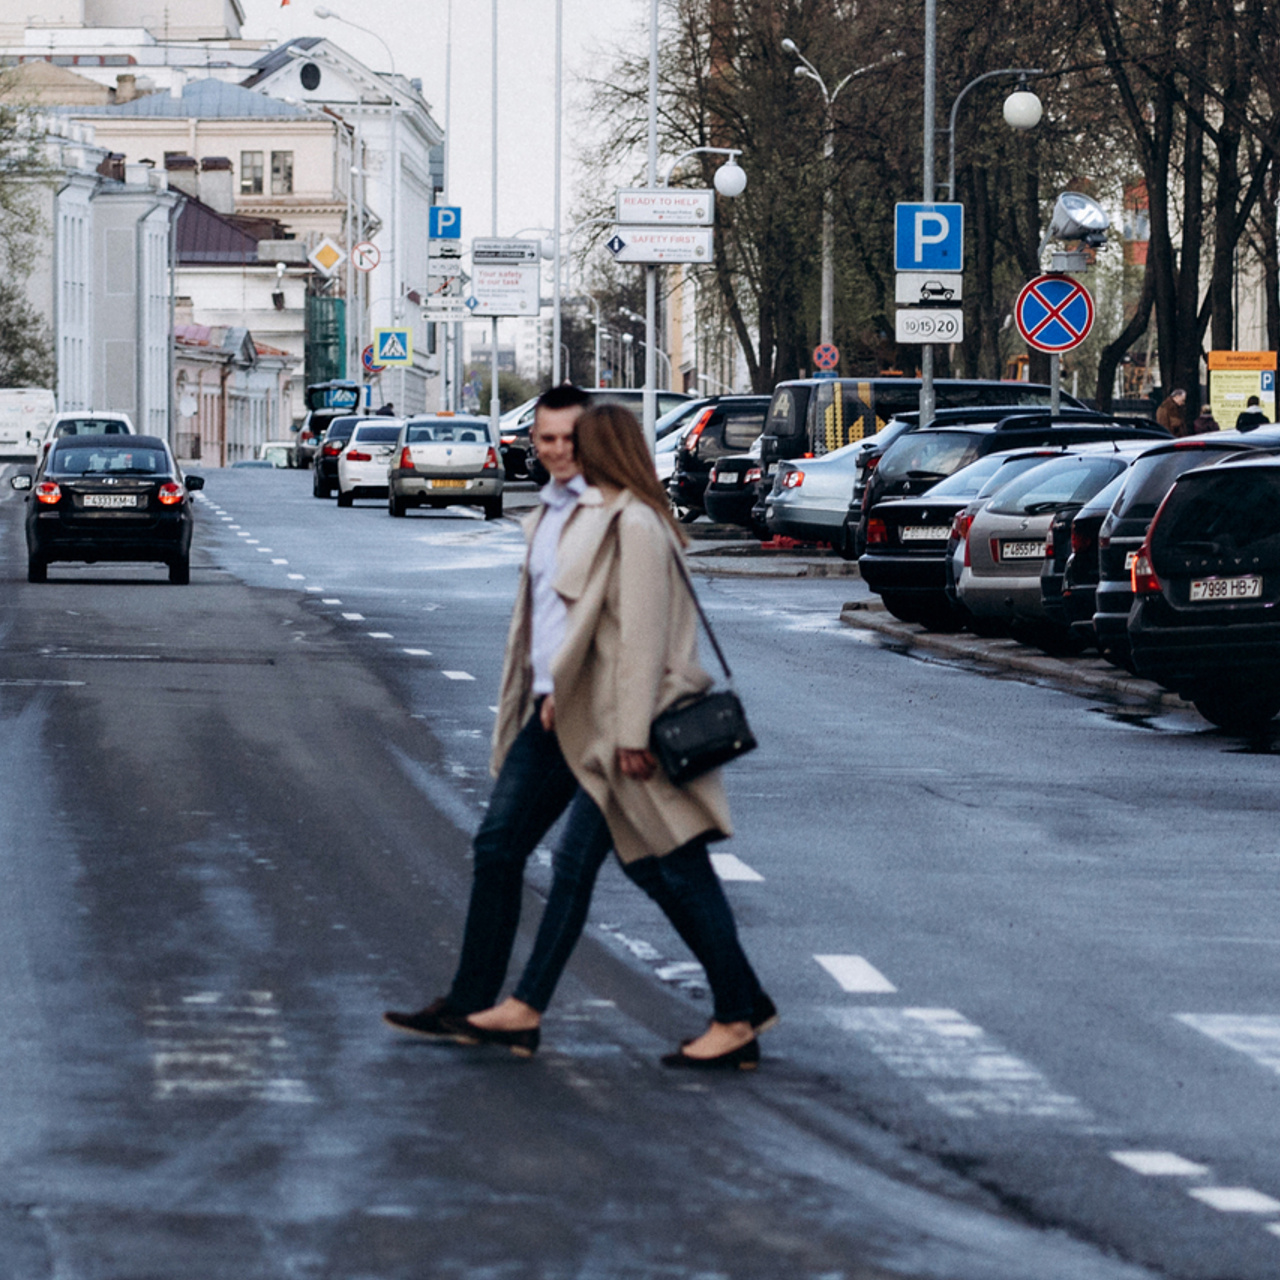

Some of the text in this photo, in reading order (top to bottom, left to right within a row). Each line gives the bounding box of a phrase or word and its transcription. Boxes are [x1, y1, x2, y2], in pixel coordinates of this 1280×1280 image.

[623, 197, 656, 205] READY
[674, 198, 699, 206] HELP
[437, 210, 456, 236] P
[631, 235, 667, 243] SAFETY
[914, 211, 950, 263] P
[905, 320, 955, 332] 10 15 20
[1262, 373, 1272, 389] P
[1201, 579, 1259, 597] 7998 HB-7
